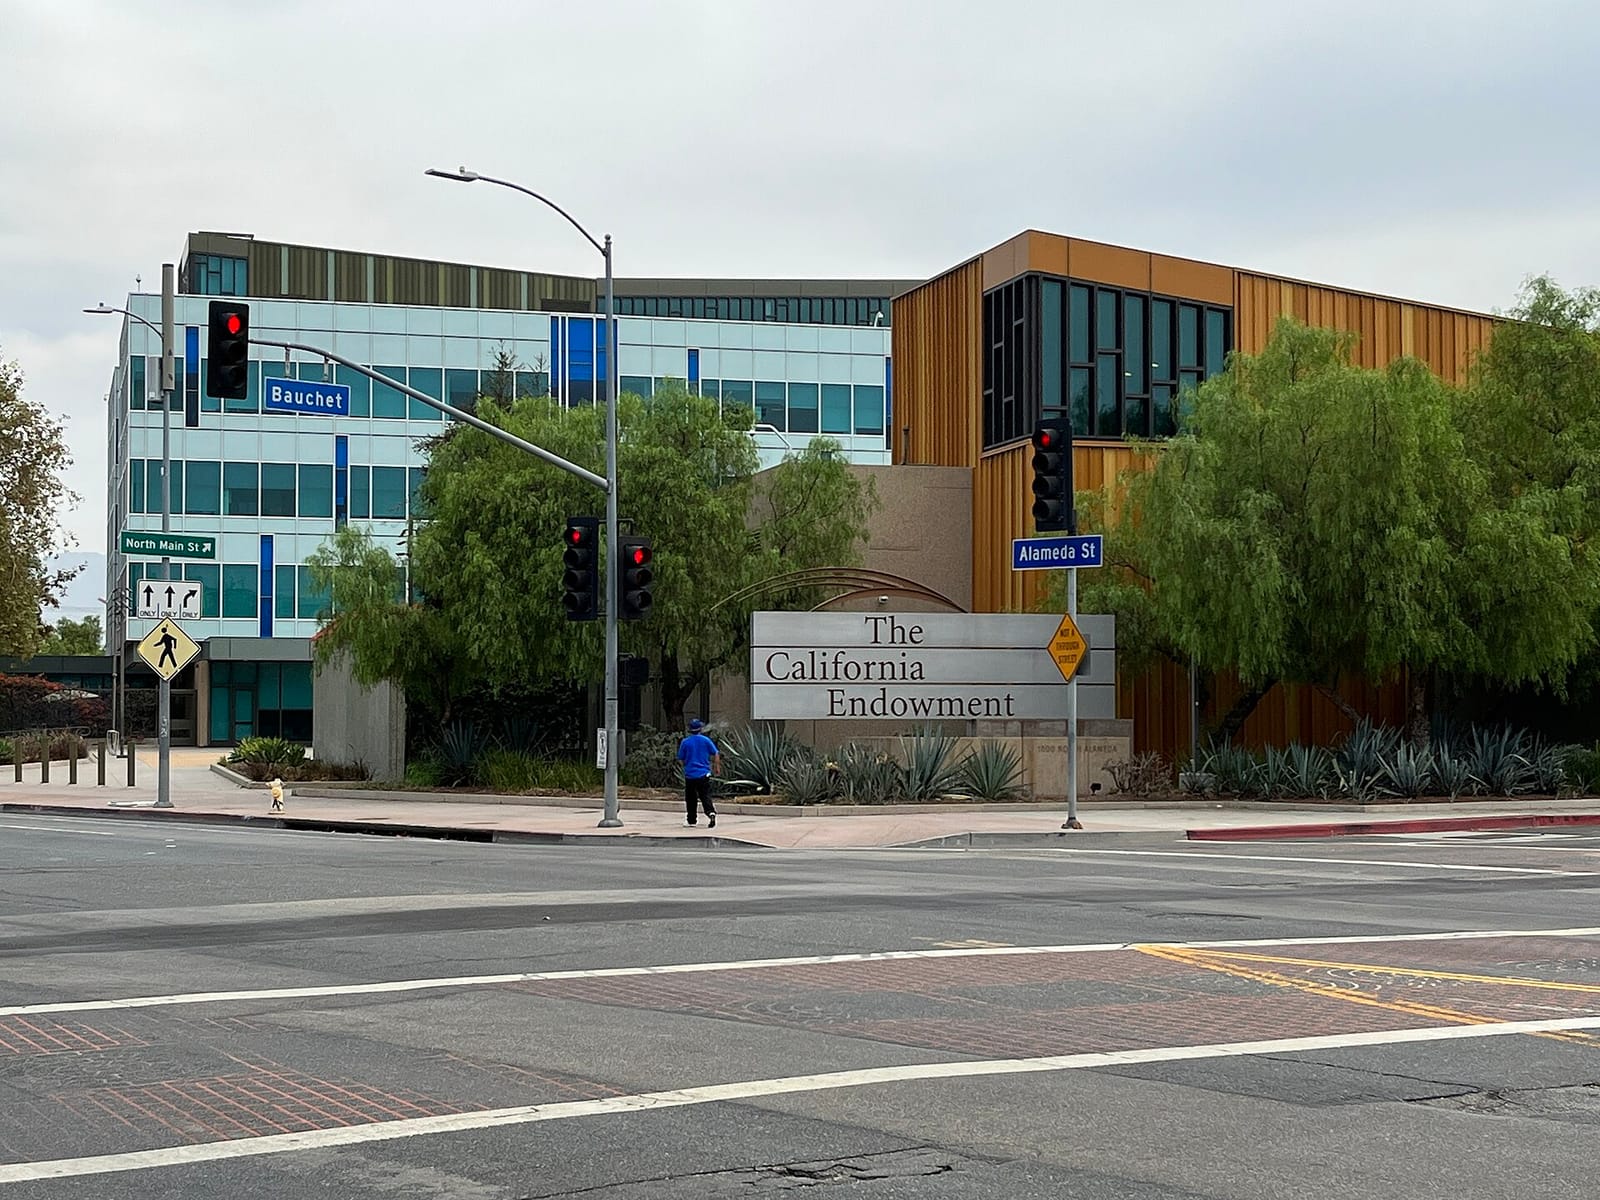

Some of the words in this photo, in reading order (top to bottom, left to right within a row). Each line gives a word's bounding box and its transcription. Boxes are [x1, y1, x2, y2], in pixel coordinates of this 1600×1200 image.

[272, 386, 342, 408] Bauchet
[126, 538, 156, 549] North
[160, 540, 184, 551] Main
[187, 542, 199, 552] St
[1019, 544, 1076, 561] Alameda
[1081, 542, 1095, 558] St
[865, 616, 924, 645] The
[766, 650, 926, 681] California
[827, 687, 1015, 717] Endowment
